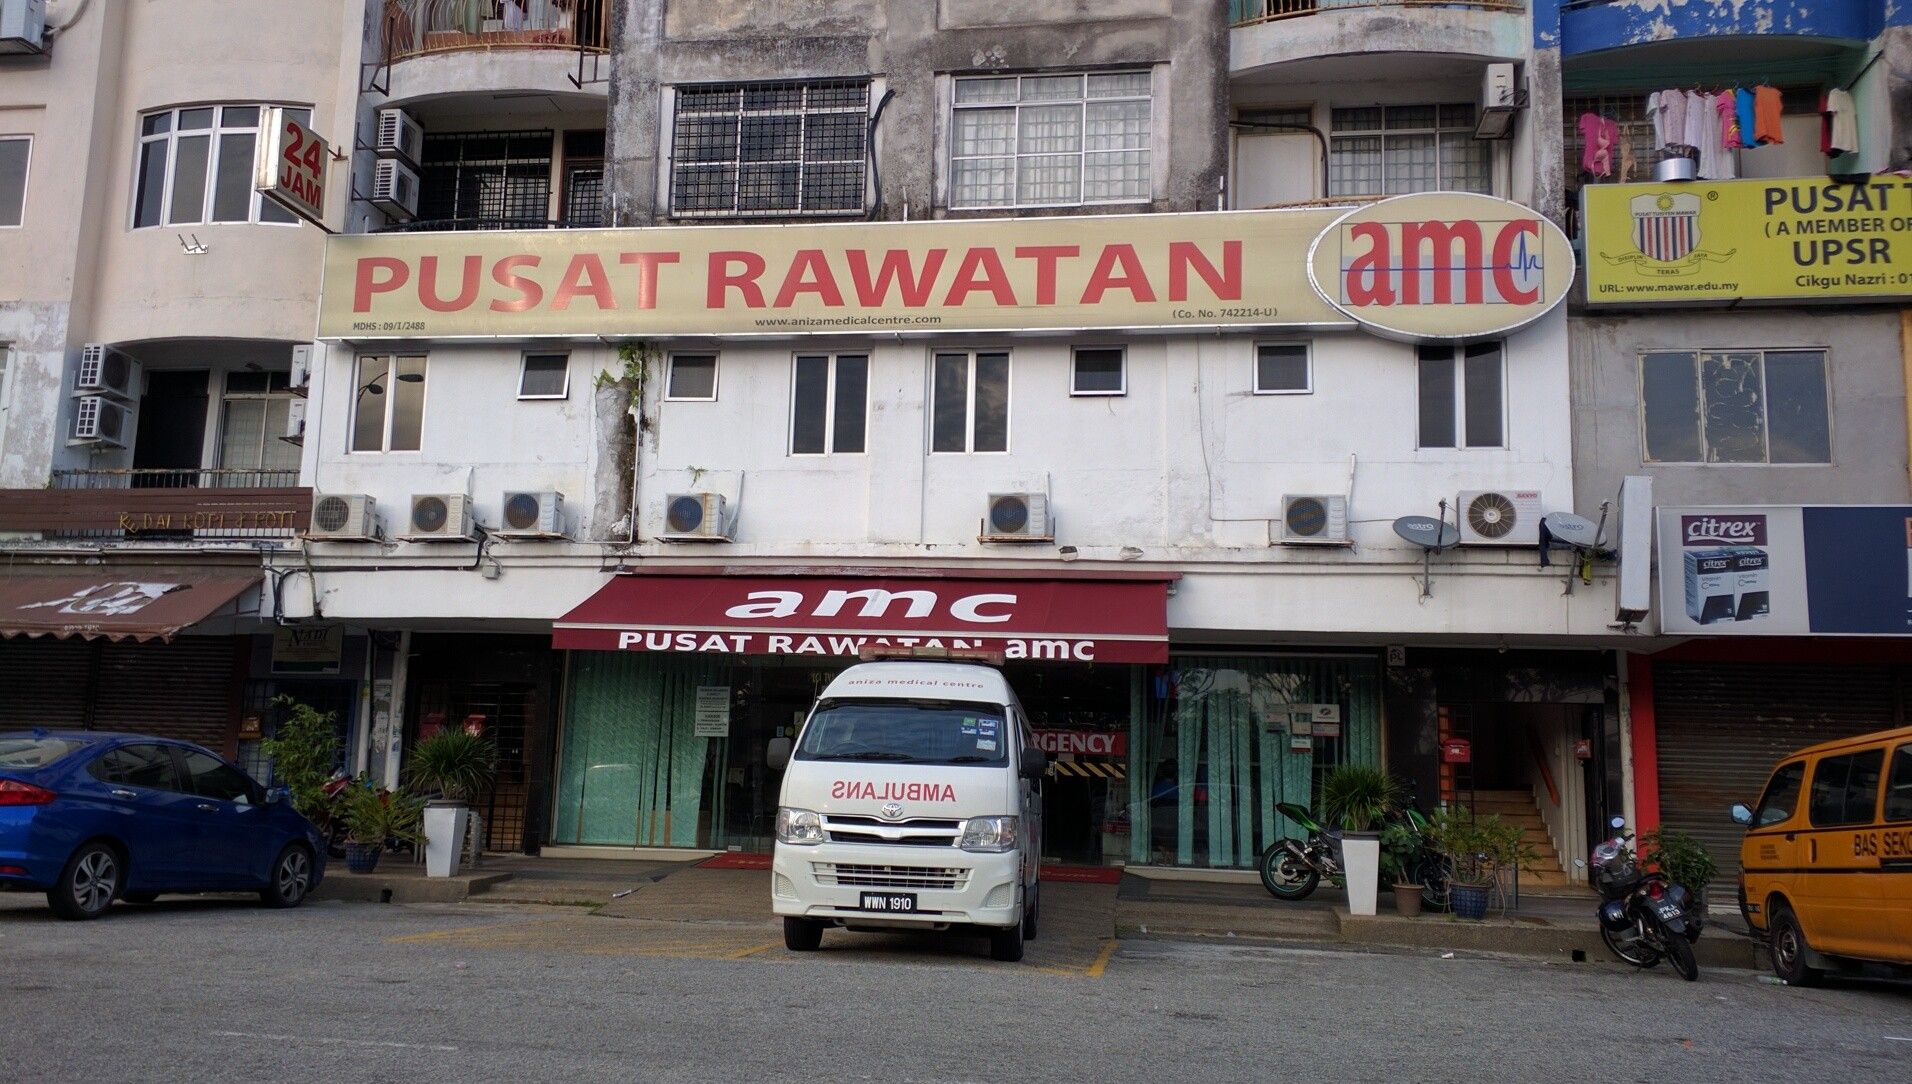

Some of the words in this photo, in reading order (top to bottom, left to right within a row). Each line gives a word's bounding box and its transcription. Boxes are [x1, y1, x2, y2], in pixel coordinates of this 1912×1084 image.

[283, 122, 322, 180] 24
[280, 165, 322, 209] JAM
[1764, 183, 1895, 215] PUSAT
[1796, 217, 1885, 234] MEMBER
[1346, 218, 1540, 308] amc
[1793, 237, 1892, 266] UPSR
[353, 251, 681, 313] PUSAT
[706, 240, 1243, 309] RAWATAN
[1600, 284, 1624, 293] URL:
[1627, 282, 1739, 293] www.mawar.edu.my
[1795, 274, 1841, 289] Cikgu
[1845, 273, 1886, 286] Nazri
[755, 315, 942, 327] www.anizamedicalcentre.com
[1198, 309, 1217, 318] No.
[1220, 307, 1279, 317] 742214-U)
[1687, 517, 1756, 537] citrex
[725, 588, 1018, 623] amc
[618, 632, 753, 653] PUSAT
[1004, 638, 1095, 661] amc
[1854, 833, 1878, 857] BAS
[864, 896, 887, 910] WWN
[890, 897, 912, 910] 1910
